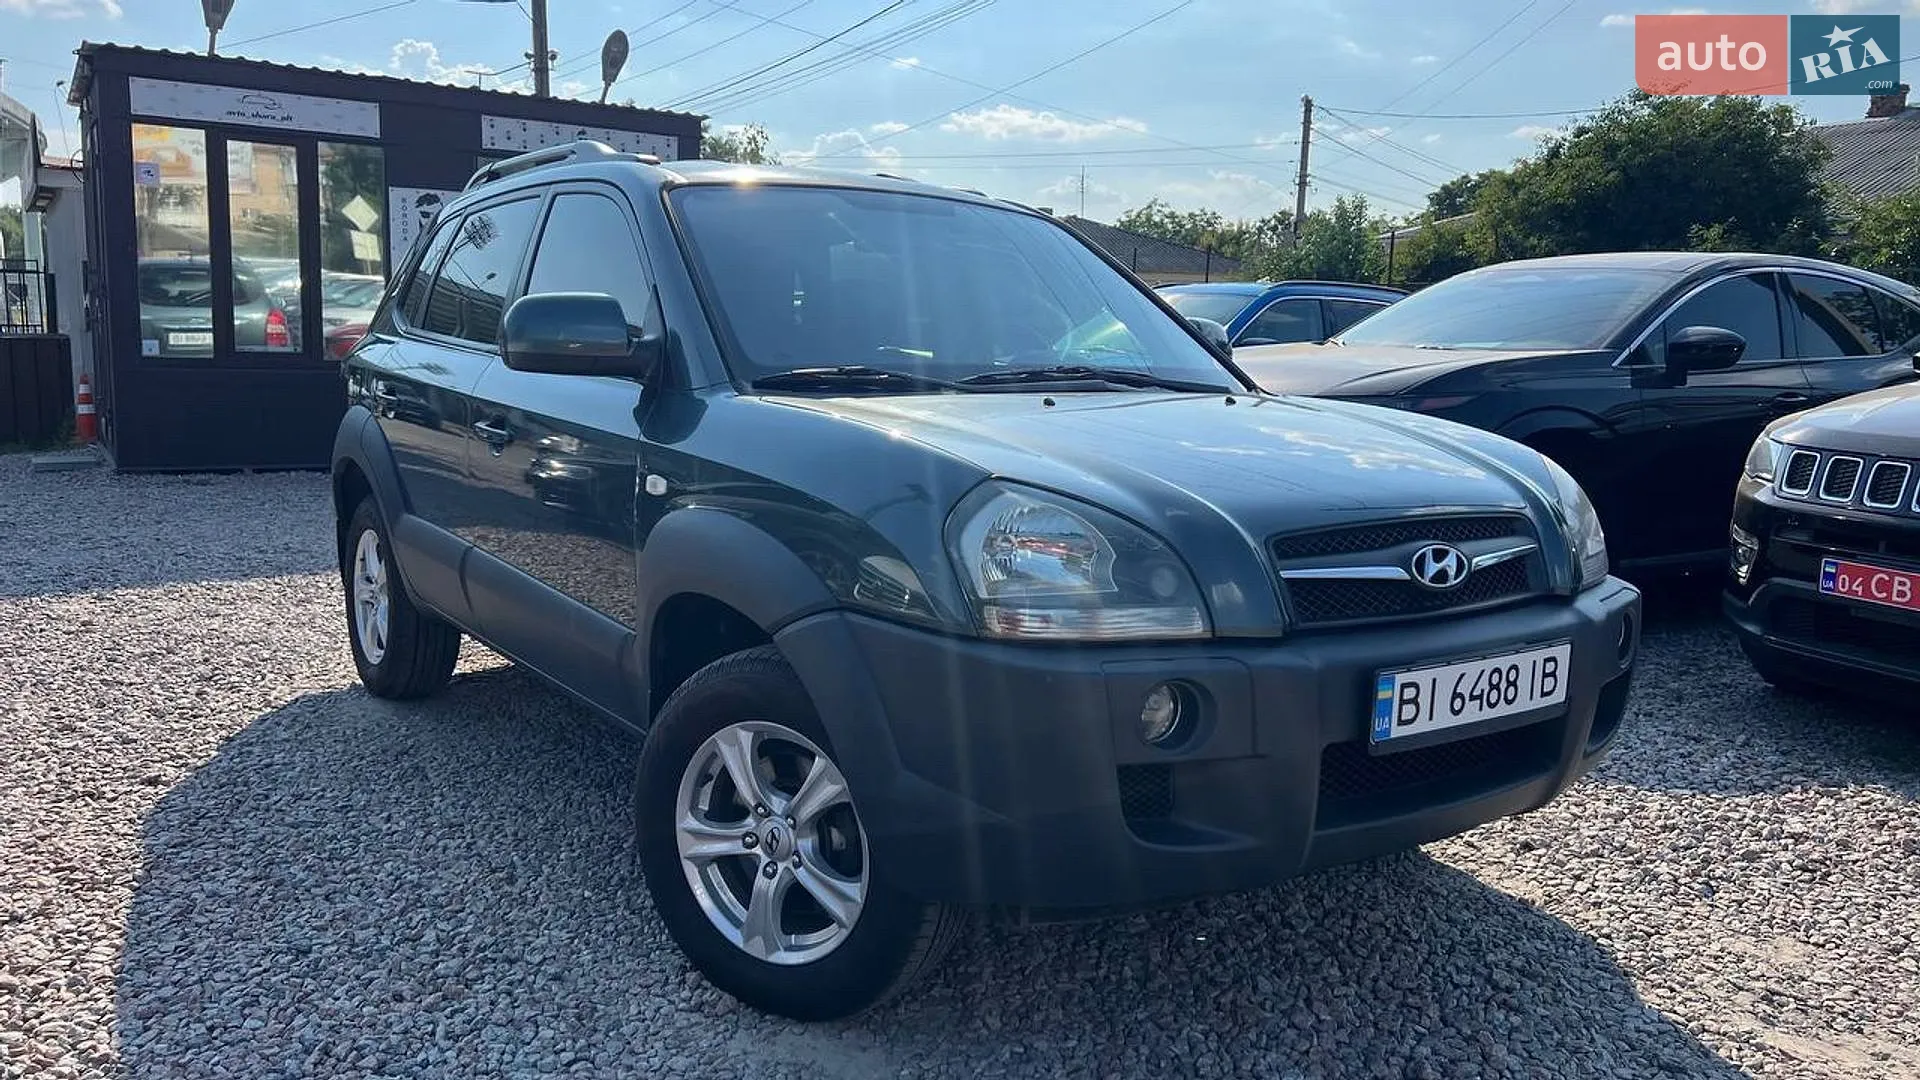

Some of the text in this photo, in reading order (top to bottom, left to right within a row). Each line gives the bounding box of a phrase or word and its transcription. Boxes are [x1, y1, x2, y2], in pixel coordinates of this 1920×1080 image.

[1822, 573, 1912, 603] UA 04 CB
[1375, 656, 1559, 732] UA BI 6488 IB
